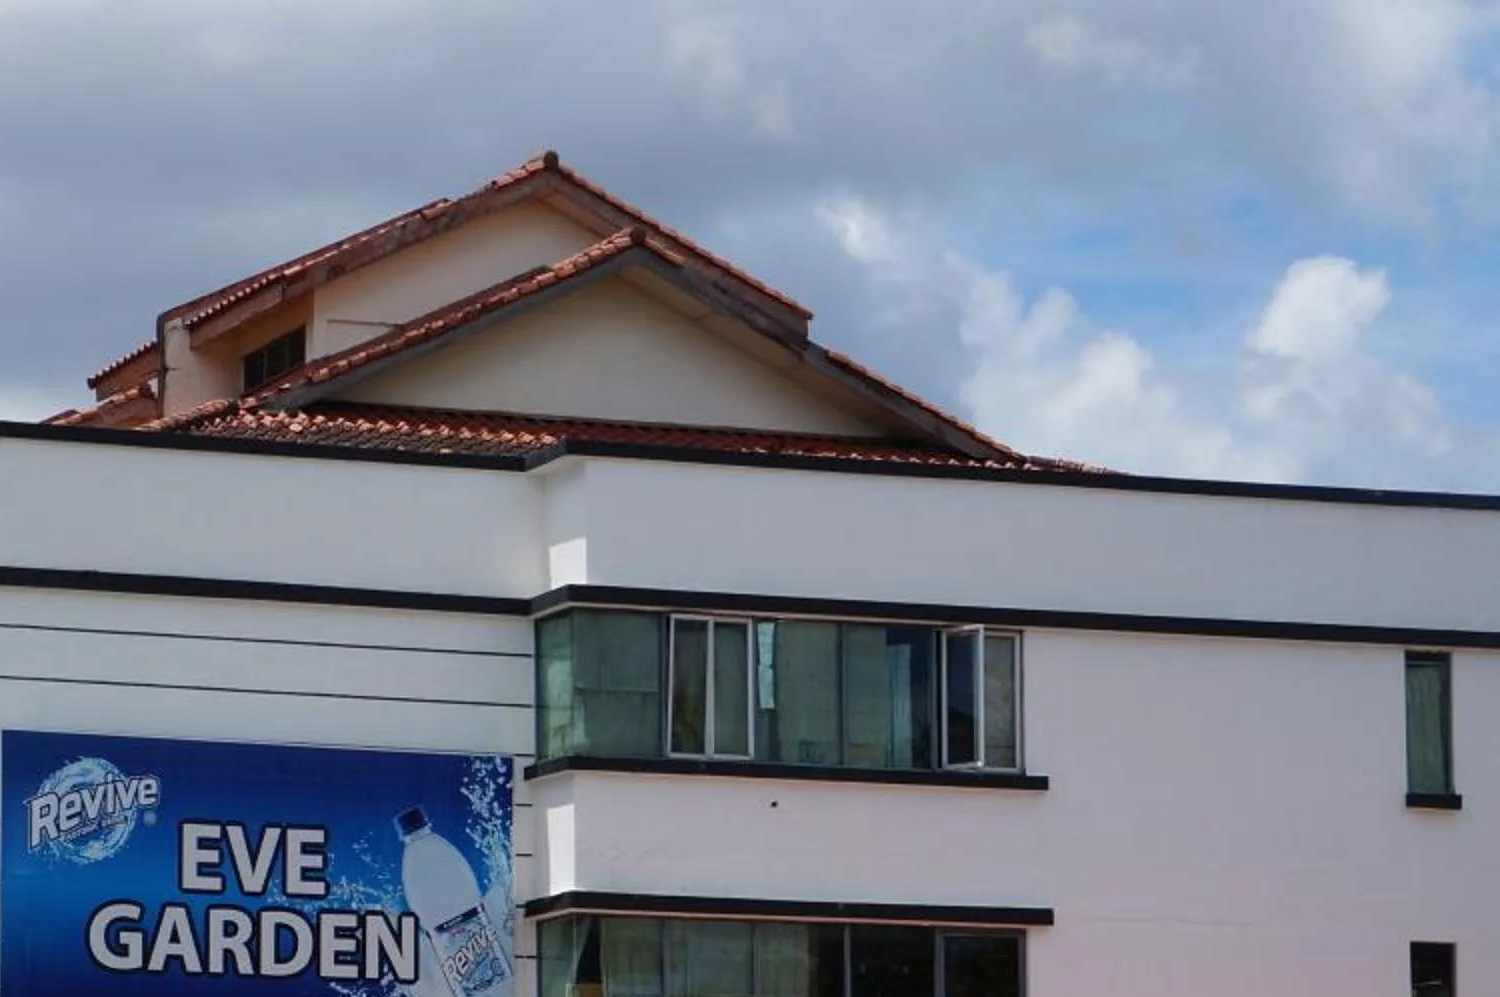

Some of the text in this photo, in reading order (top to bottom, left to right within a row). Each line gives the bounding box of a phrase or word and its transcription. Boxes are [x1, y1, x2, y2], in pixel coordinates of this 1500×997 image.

[28, 772, 160, 853] Revive
[179, 821, 328, 896] EVE
[87, 903, 419, 981] GARDEN
[442, 925, 497, 984] Revive
